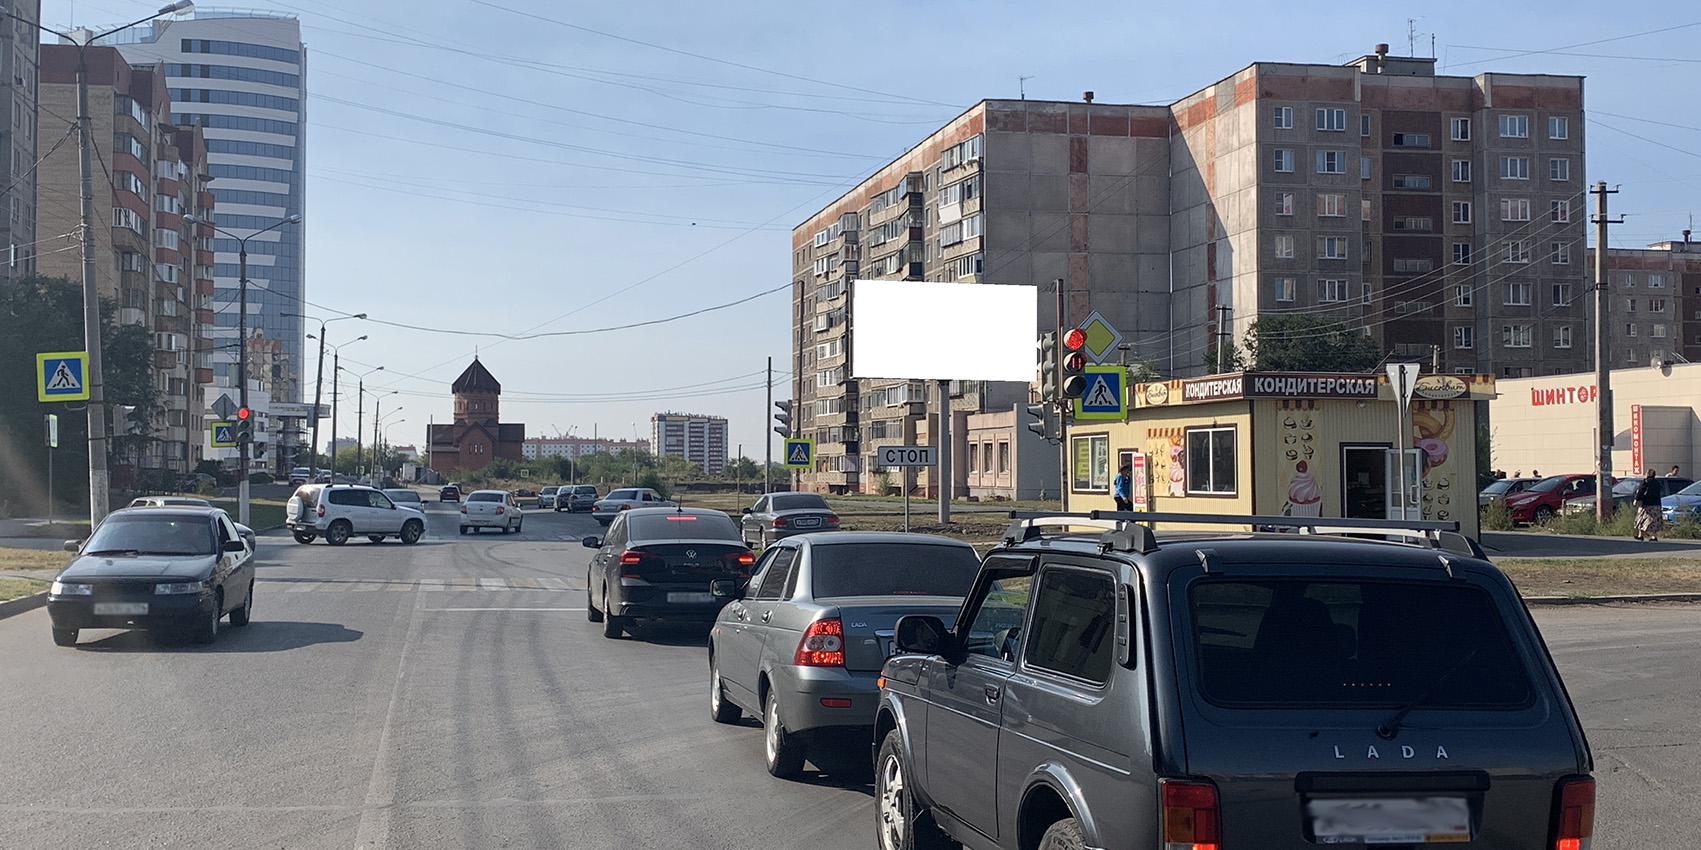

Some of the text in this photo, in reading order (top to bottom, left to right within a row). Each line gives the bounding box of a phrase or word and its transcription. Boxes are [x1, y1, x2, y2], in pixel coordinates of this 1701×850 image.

[1185, 379, 1242, 399] КОНДИТЕРСКАЯ
[1254, 377, 1375, 395] КОНДИТЕРСКАЯ
[1632, 405, 1640, 474] ШИНОМОНТАЖ
[886, 450, 928, 463] СТОП
[1333, 745, 1449, 759] LADA
